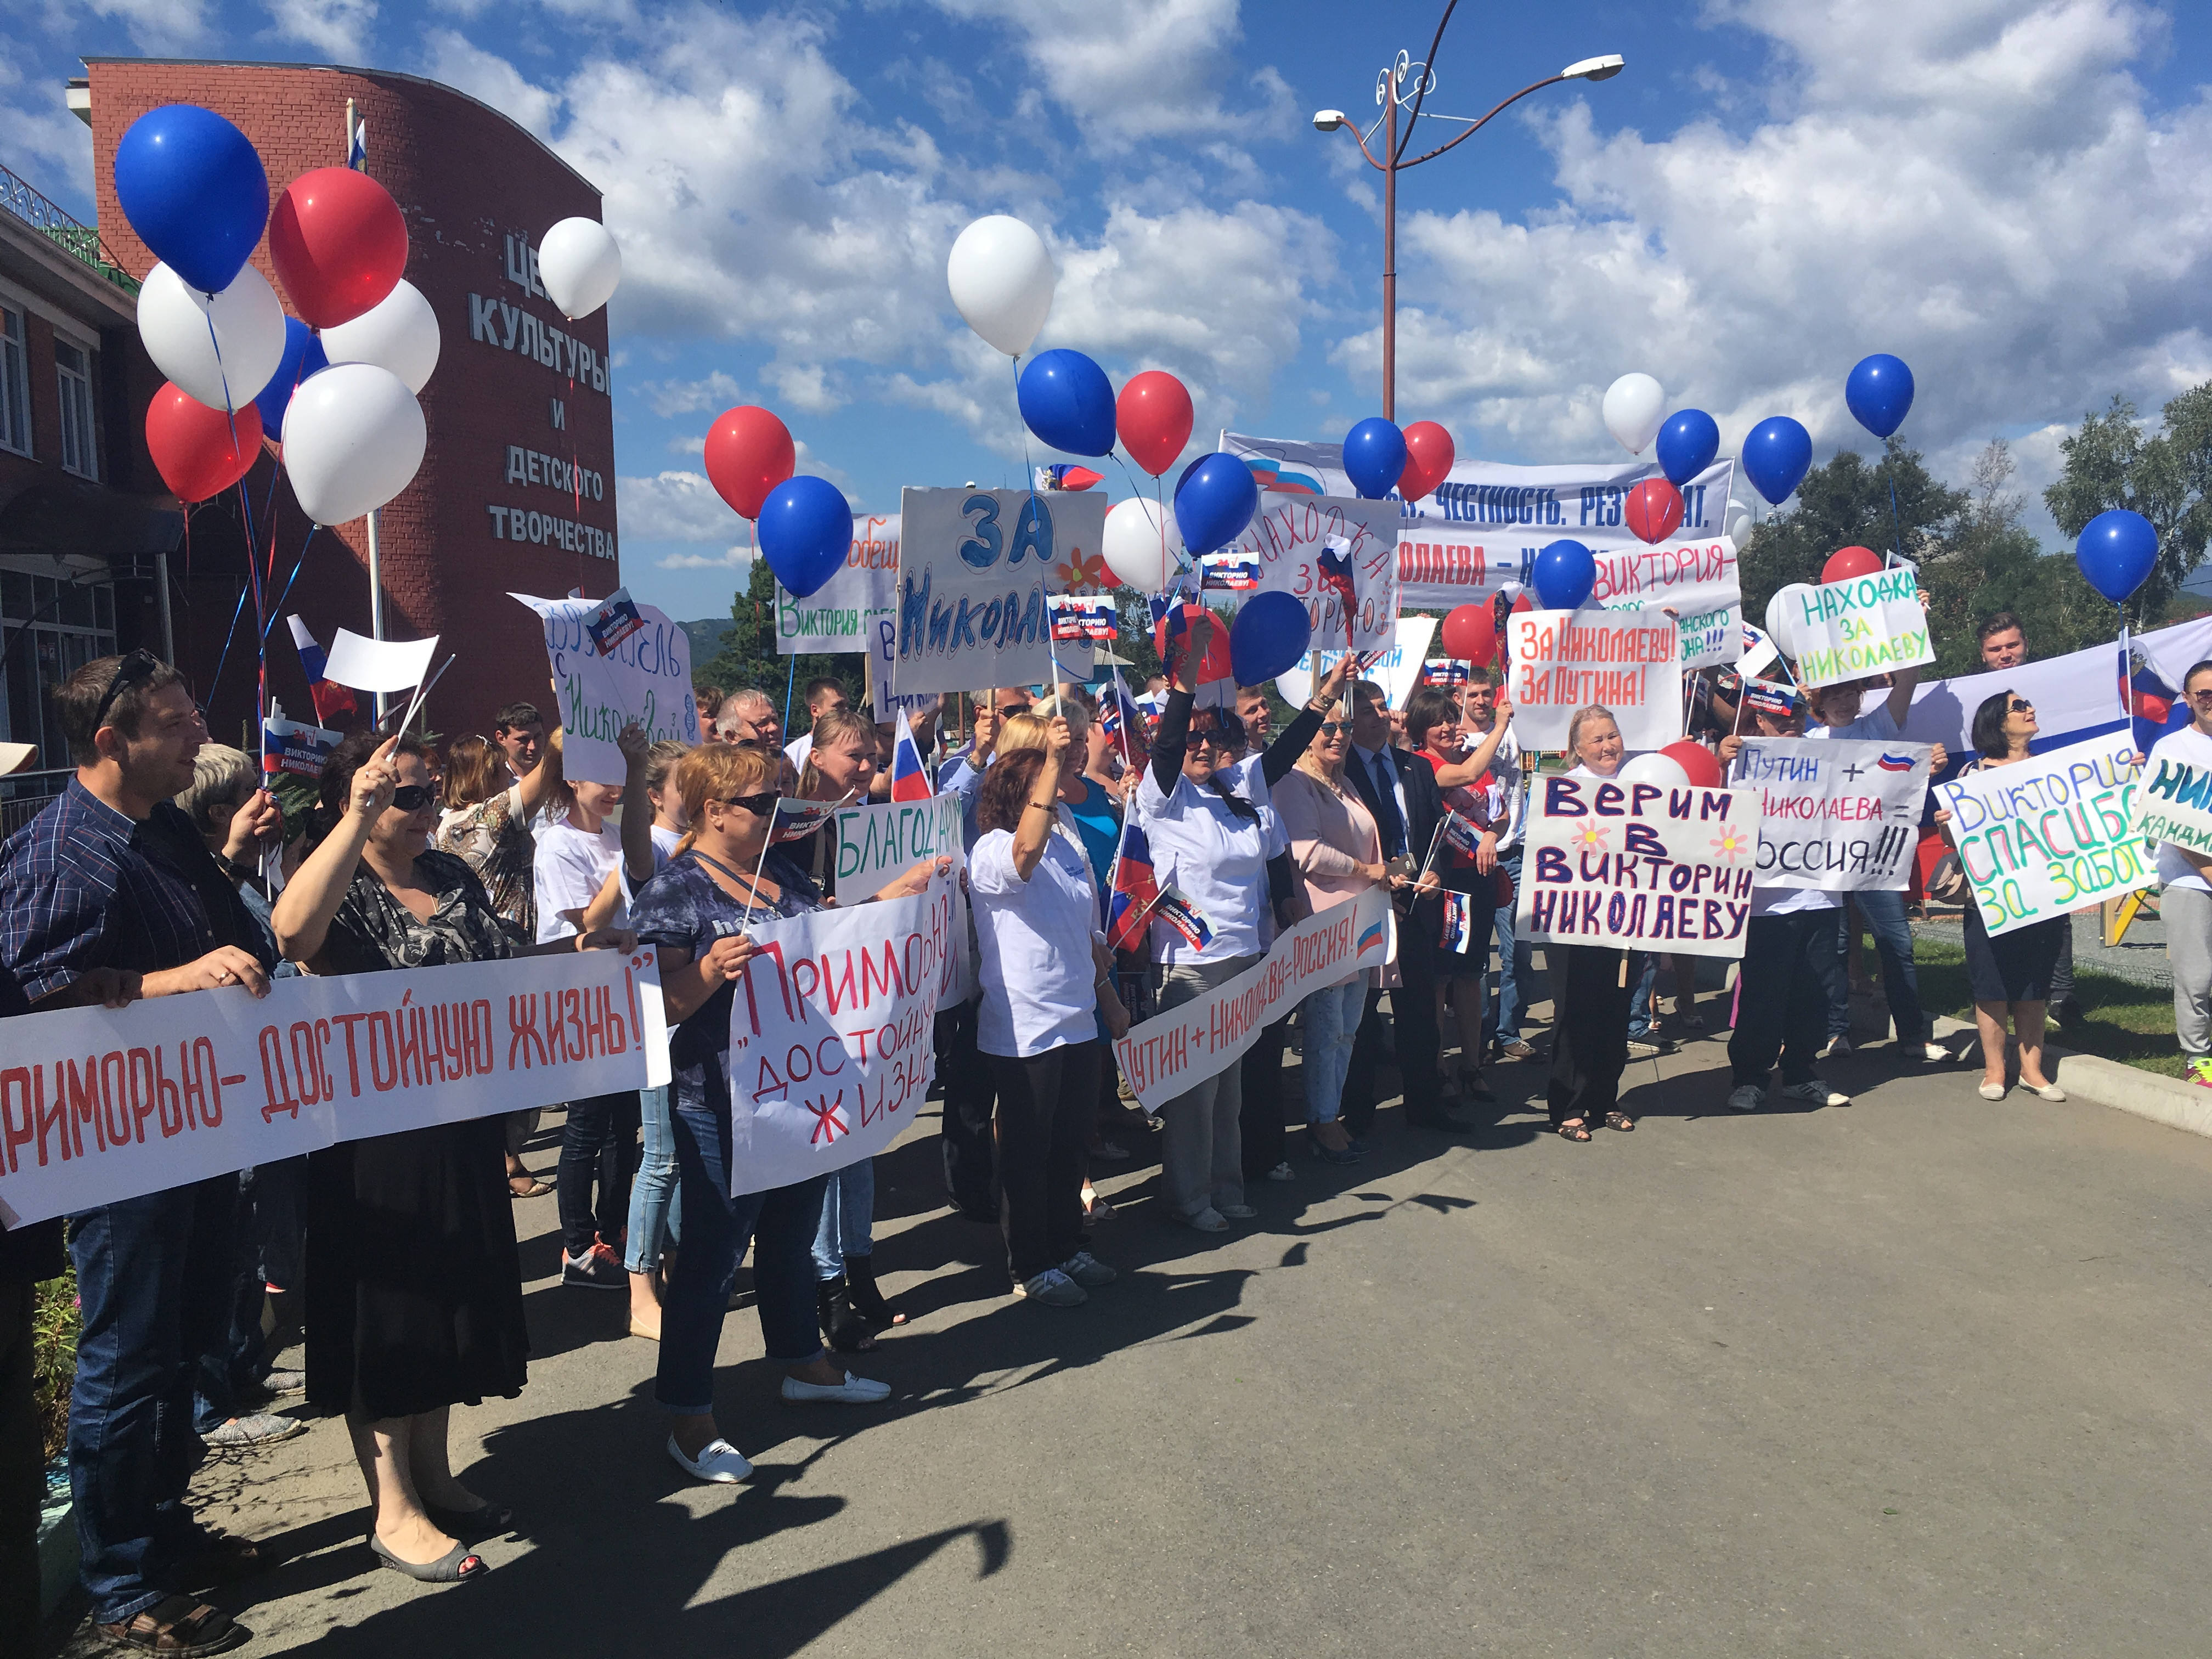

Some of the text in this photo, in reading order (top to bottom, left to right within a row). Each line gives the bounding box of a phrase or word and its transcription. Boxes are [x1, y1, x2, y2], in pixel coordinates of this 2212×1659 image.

[469, 292, 611, 396] КУЛЬТУРЫ
[551, 398, 565, 431] И
[507, 445, 603, 501] ДЕТСКОГО
[1436, 482, 1566, 526] ЧЕСТНОСТЬ.
[488, 505, 615, 561] ТВОРЧЕСТВА
[958, 494, 1056, 569] ЗА
[1073, 603, 1086, 612] ЗА
[1801, 571, 1919, 626] НАХОДКА
[602, 613, 628, 637] ВИКТОРИЮ
[605, 620, 634, 648] НИКОЛАЕВУ!
[1520, 617, 1677, 663] ЗА НИКОЛАЕВУ!
[1840, 617, 1874, 643] ЗА
[1801, 628, 1928, 684] НИКОЛАЕВУ
[1520, 664, 1645, 707] ЗА ПУТИНА!
[1750, 693, 1782, 704] ВИКТОРИЮ
[1747, 699, 1784, 712] НИКОЛАЕВУ!
[293, 729, 307, 742] ЗА
[2149, 759, 2212, 814] НИ
[803, 807, 820, 815] ЗА
[838, 795, 963, 878] БЛАГОДАРИМ
[1449, 828, 1470, 846] ВИКТОРИЮ
[1624, 822, 1669, 857] В
[2137, 811, 2212, 853] КАНДИ
[1165, 904, 1201, 934] ВИКТОРИЮ
[1180, 899, 1192, 911] ЗА
[1531, 889, 1750, 940] НИКОЛАЕВУ
[1158, 908, 1198, 941] НИКОЛАЕВУ!
[0, 1036, 246, 1176] РИМОРЬЮ-
[259, 988, 494, 1124] ДОСТОЙНУЮ
